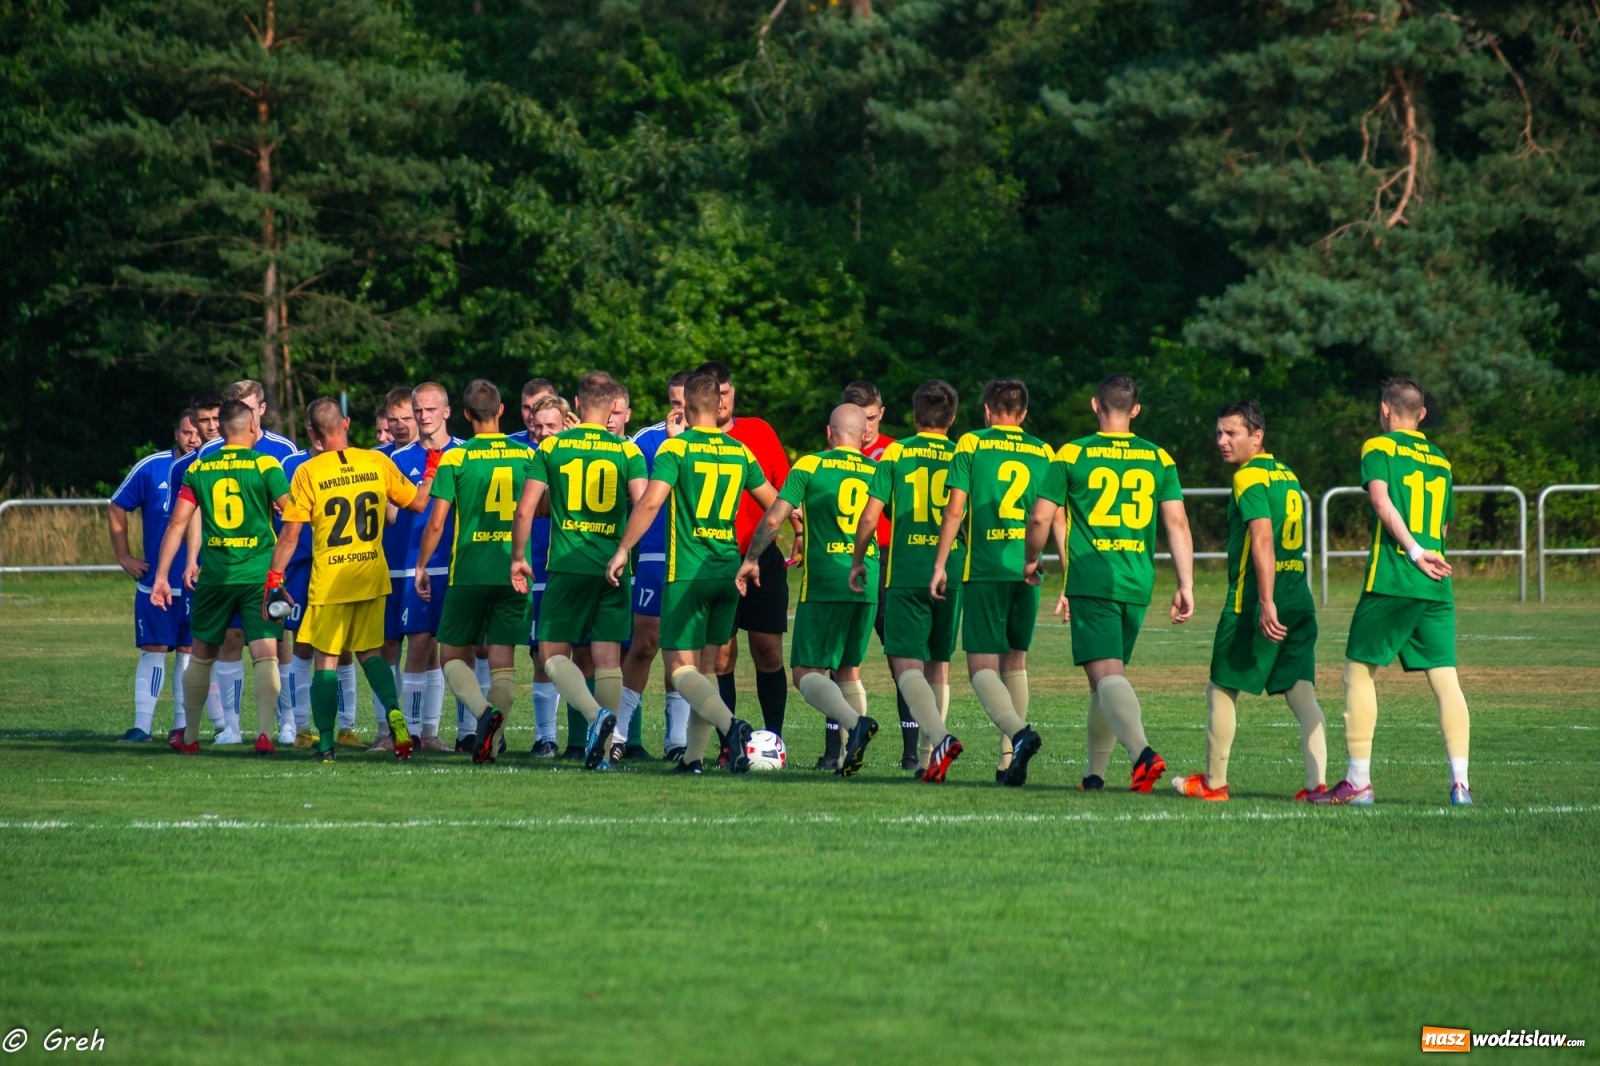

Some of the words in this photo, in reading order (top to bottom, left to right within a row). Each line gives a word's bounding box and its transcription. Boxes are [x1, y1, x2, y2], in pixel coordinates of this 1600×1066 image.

[467, 448, 500, 460] NAPRZÓD
[501, 448, 529, 459] ZAWADA
[558, 438, 592, 450] NAPRZÓD
[592, 440, 622, 452] ZAWADA
[902, 447, 937, 460] NAPRZÓD
[938, 451, 954, 462] ZAW
[979, 439, 1014, 452] NAPRZÓD
[1086, 446, 1122, 459] NAPRZÓD
[1123, 448, 1156, 461] ZAWADA
[340, 466, 355, 474] 1946
[822, 458, 855, 471] NAPRZÓD
[856, 462, 876, 475] ZAW
[318, 475, 351, 491] NAPRZÓD
[351, 472, 379, 484] ZAWADA
[559, 457, 618, 513] 10
[694, 461, 743, 520] 77
[997, 460, 1031, 520] 2
[212, 477, 244, 529] 6
[485, 466, 518, 521] 4
[904, 466, 952, 526] 19
[1087, 466, 1156, 530] 23
[836, 477, 869, 535] 9
[1402, 469, 1447, 540] 11
[324, 490, 380, 548] 26
[1281, 488, 1303, 550] 8
[472, 531, 513, 542] LSM-SPOR
[692, 526, 734, 541] LSM-SPOR.pl
[986, 528, 1026, 540] LSM-SPO
[328, 549, 378, 565] LSM-SPORT.pl
[638, 587, 655, 607] 17
[401, 607, 409, 626] 4
[826, 722, 839, 730] na
